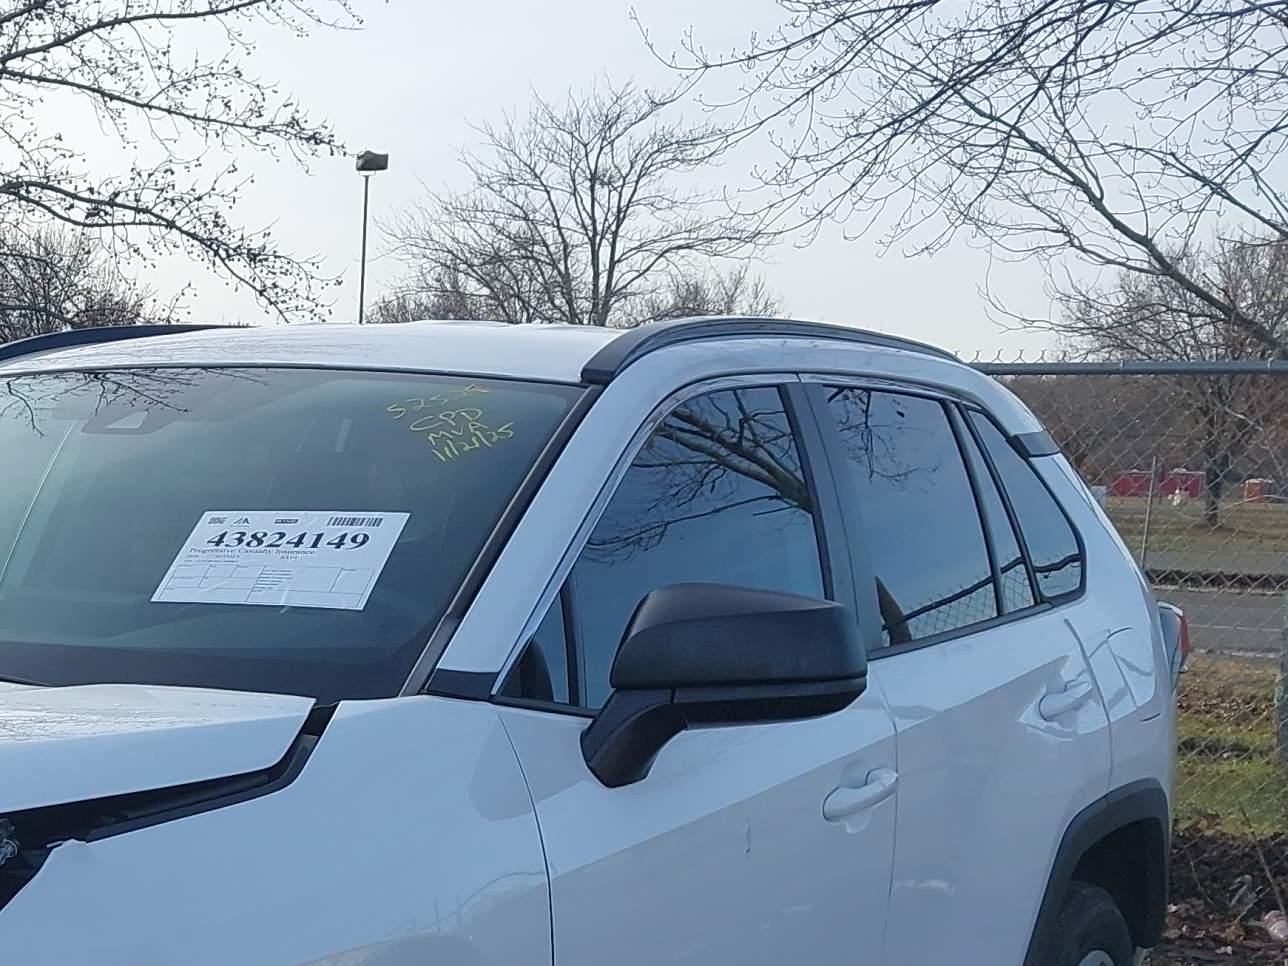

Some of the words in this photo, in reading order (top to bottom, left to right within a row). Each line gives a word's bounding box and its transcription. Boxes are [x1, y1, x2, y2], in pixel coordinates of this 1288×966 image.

[409, 407, 483, 432] CPD
[206, 530, 370, 550] 43824149
[188, 547, 238, 555] Progressive
[275, 548, 317, 556] Insurance
